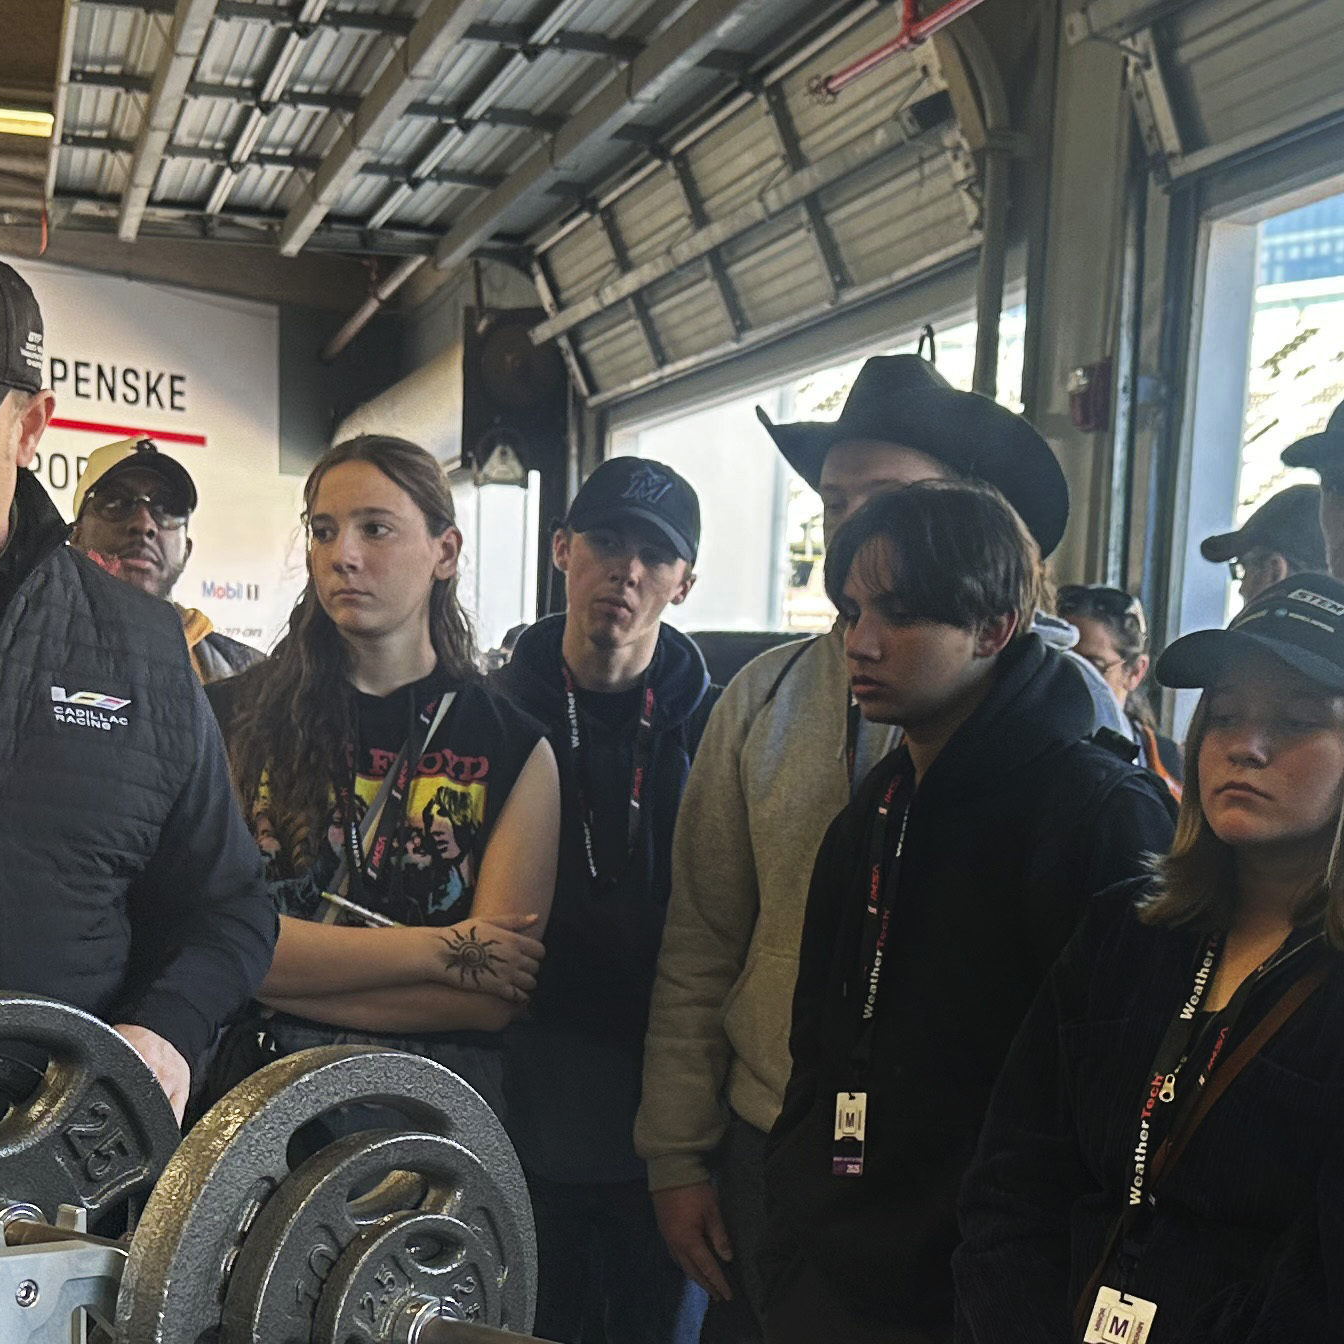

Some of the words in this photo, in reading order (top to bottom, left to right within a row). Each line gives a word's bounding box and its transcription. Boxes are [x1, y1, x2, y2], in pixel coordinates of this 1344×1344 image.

[50, 357, 187, 412] PENSKE
[201, 580, 244, 600] Mobil
[53, 705, 129, 726] CADILLAC
[55, 713, 112, 731] RACING
[562, 667, 581, 749] Weather
[369, 748, 490, 783] FOYD
[870, 863, 881, 901] IMSA
[862, 908, 891, 1020] WeatherTech
[1180, 934, 1219, 1020] WeatherT
[845, 1112, 855, 1128] M
[60, 1102, 130, 1183] 25
[1129, 1074, 1164, 1206] WeatherTech
[1109, 1315, 1130, 1339] M
